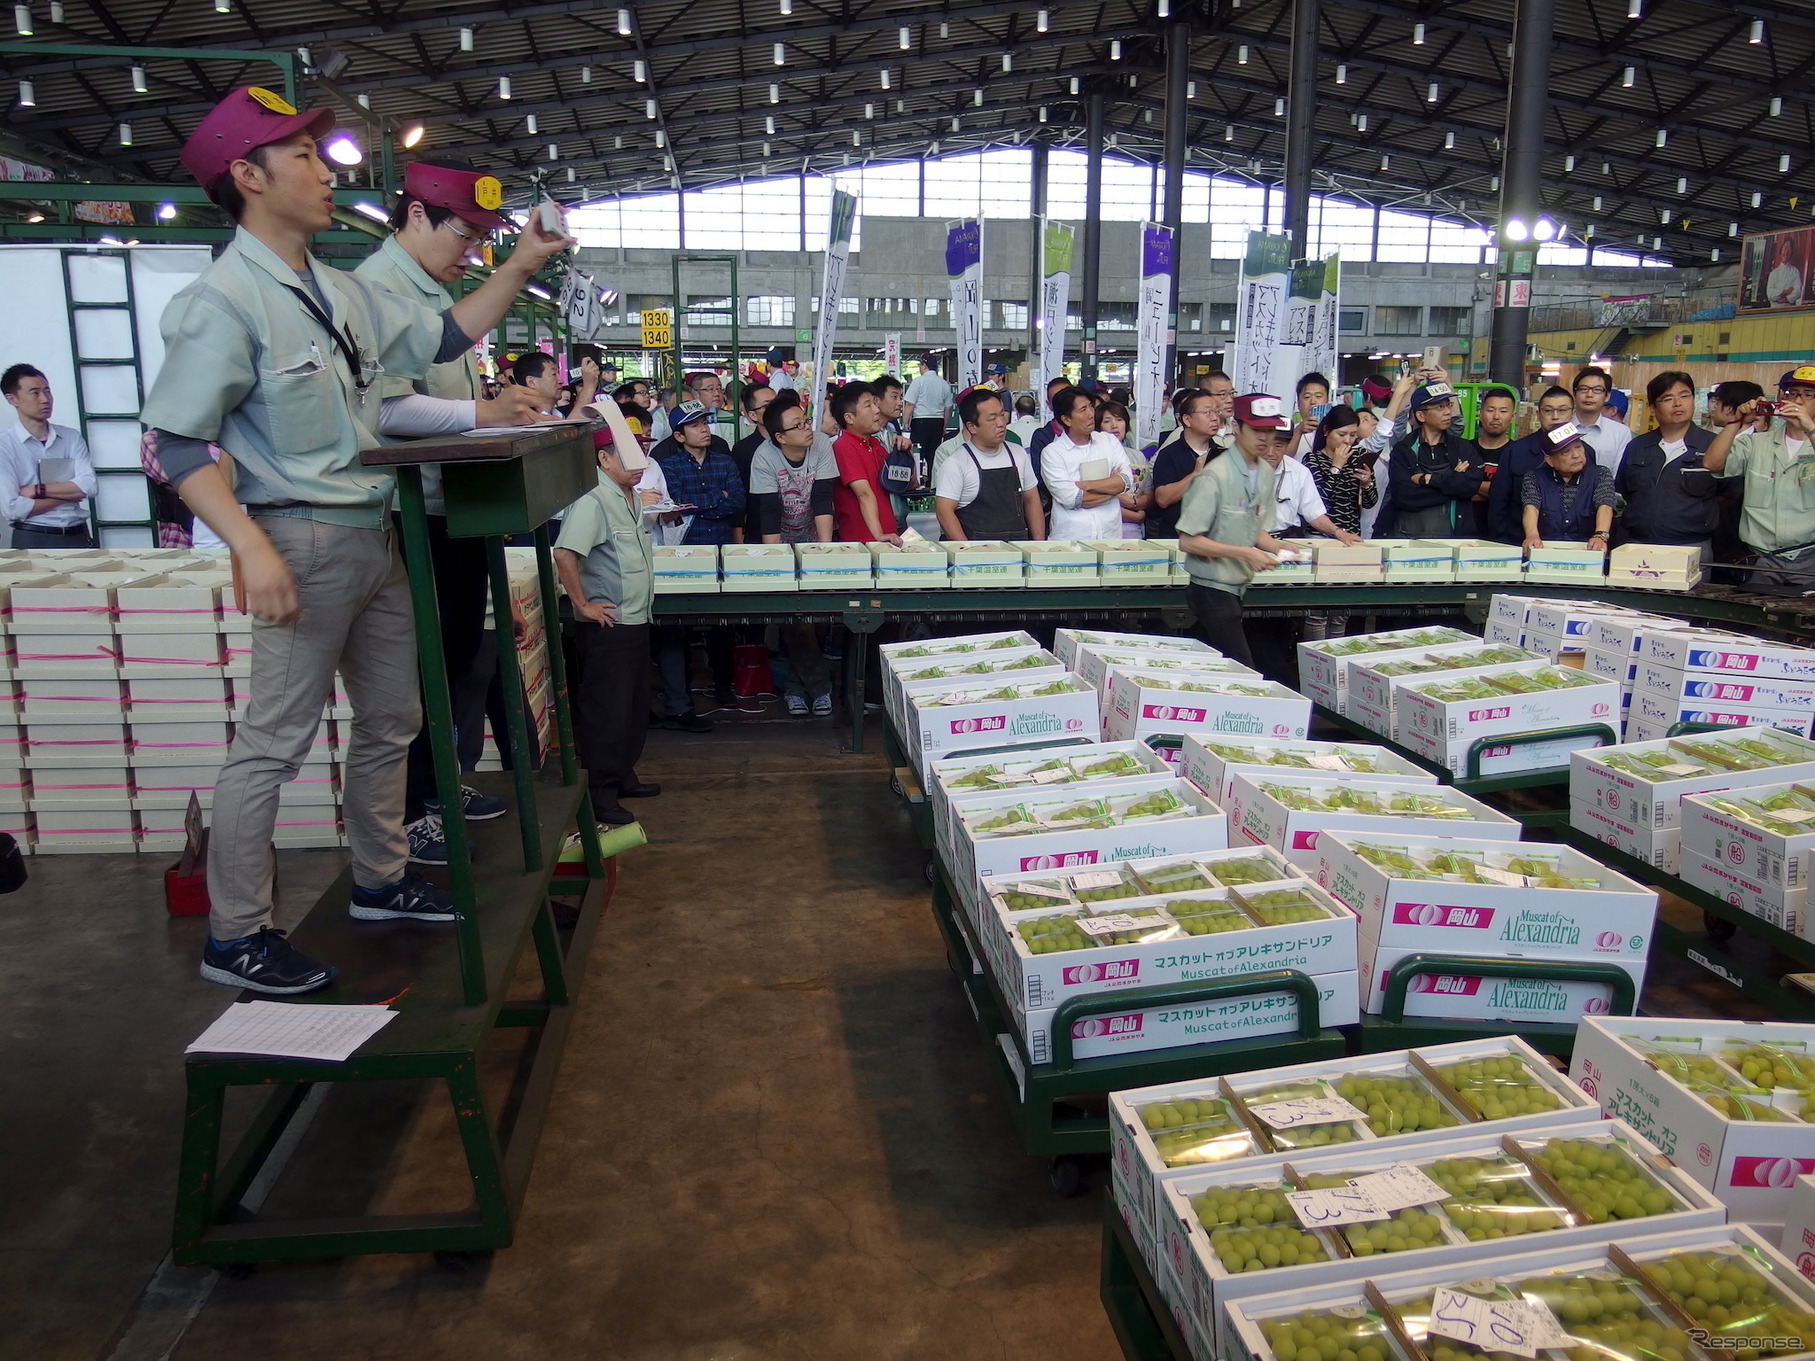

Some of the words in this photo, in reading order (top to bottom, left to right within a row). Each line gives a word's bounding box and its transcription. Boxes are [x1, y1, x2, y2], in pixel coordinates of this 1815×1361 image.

[643, 313, 669, 327] 1330
[643, 331, 669, 345] 1340
[1724, 654, 1749, 669] 岡山
[1720, 685, 1745, 700] 岡山
[1018, 713, 1038, 722] Muscat
[1176, 708, 1198, 721] 岡山
[1224, 710, 1243, 719] Muscat
[1490, 707, 1508, 719] 岡山
[981, 717, 1001, 731] 岡山
[1008, 713, 1062, 736] Alexandria
[1211, 714, 1264, 735] Alexandria
[1492, 746, 1508, 757] 岡山
[1114, 847, 1141, 858] Muscat
[1142, 843, 1150, 855] of
[1063, 852, 1092, 867] 岡山
[1446, 907, 1480, 927] 岡山
[1519, 909, 1550, 923] Muscat
[1550, 910, 1559, 923] of
[1499, 915, 1581, 945] Alexandria
[1104, 961, 1133, 979] 岡山
[1433, 976, 1467, 993] 岡山
[1508, 977, 1536, 990] Muscat
[1486, 982, 1569, 1010] Alexandria
[1109, 1016, 1137, 1033] 岡山
[1242, 1011, 1298, 1027] Alexandr
[1583, 1058, 1602, 1082] 岡山
[1615, 1087, 1655, 1126] マスカット
